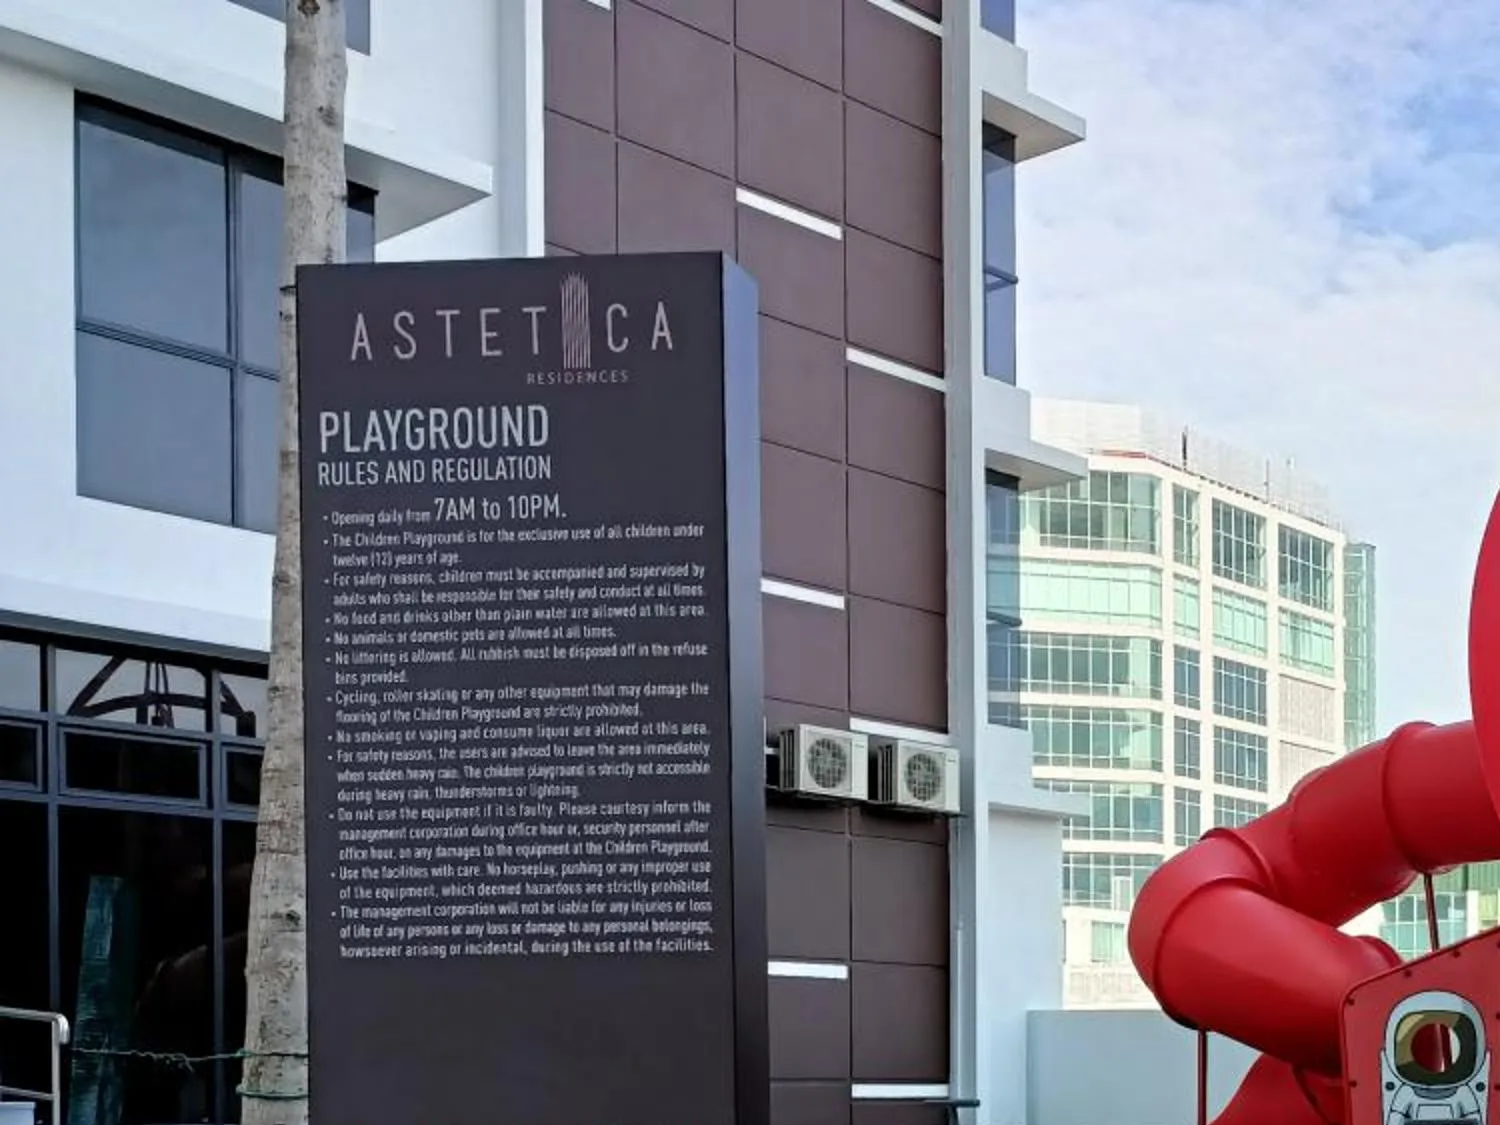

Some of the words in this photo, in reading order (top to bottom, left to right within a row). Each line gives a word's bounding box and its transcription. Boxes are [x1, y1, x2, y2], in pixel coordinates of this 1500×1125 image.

[526, 369, 629, 385] RESIDENCES
[319, 405, 550, 453] PLAYGROUND
[318, 460, 379, 486] RULES
[385, 459, 425, 484] AND
[431, 455, 552, 483] REGULATION
[434, 497, 475, 521] 7AM
[482, 500, 501, 520] to
[507, 493, 568, 519] 10PM.
